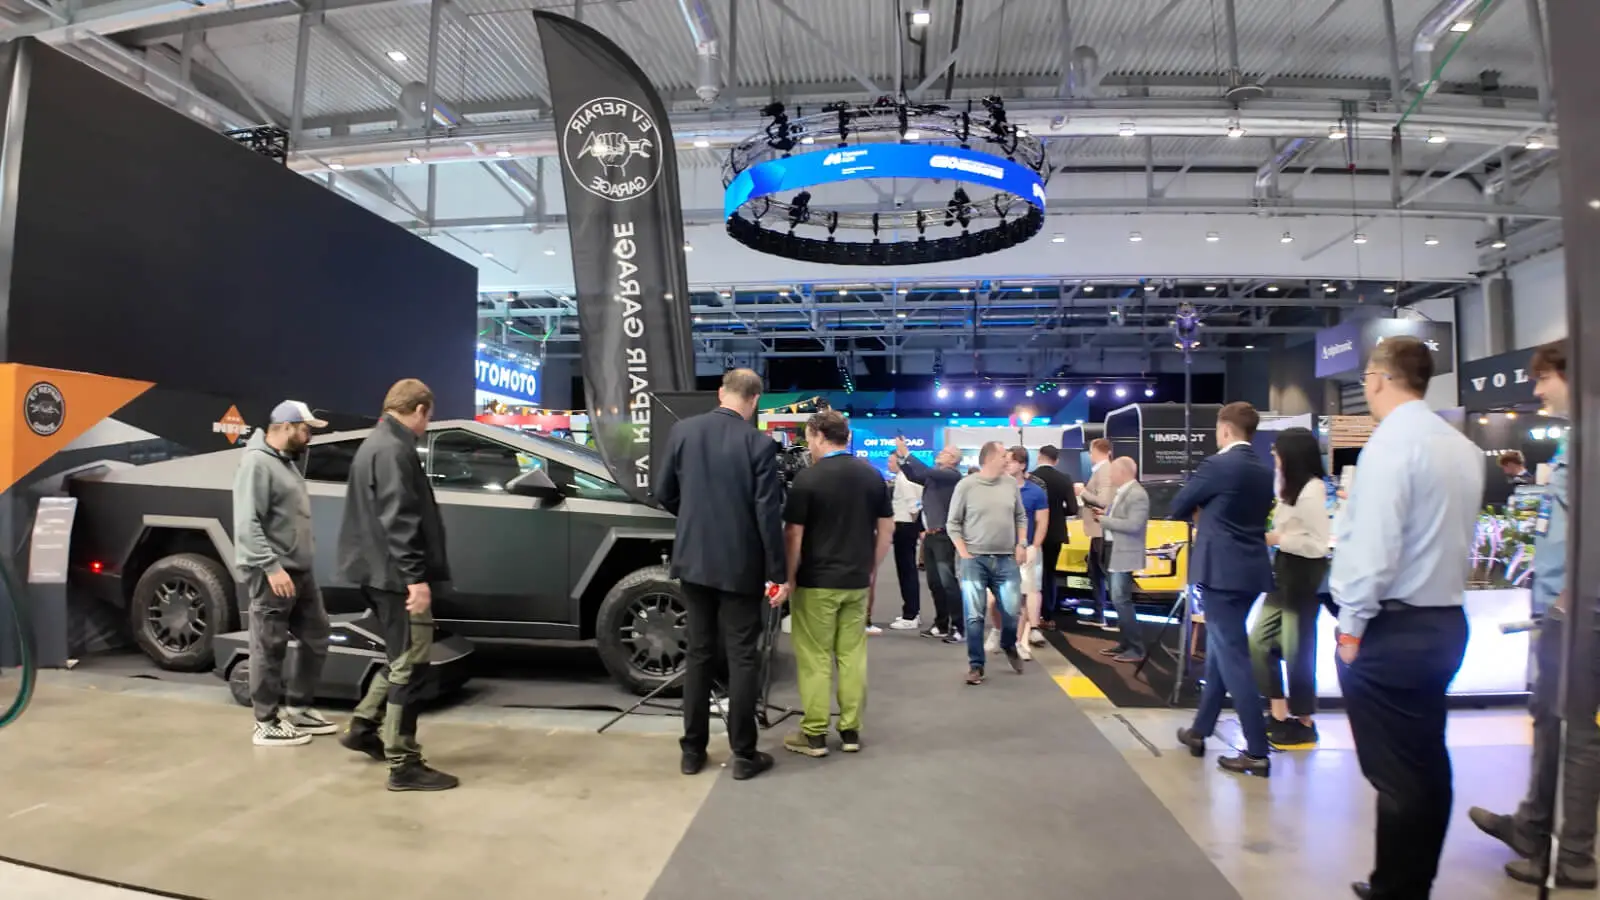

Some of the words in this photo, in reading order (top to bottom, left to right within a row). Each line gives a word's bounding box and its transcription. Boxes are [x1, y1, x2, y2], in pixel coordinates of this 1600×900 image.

[1471, 368, 1529, 391] VOL
[856, 450, 869, 458] TO
[870, 450, 889, 458] MAS
